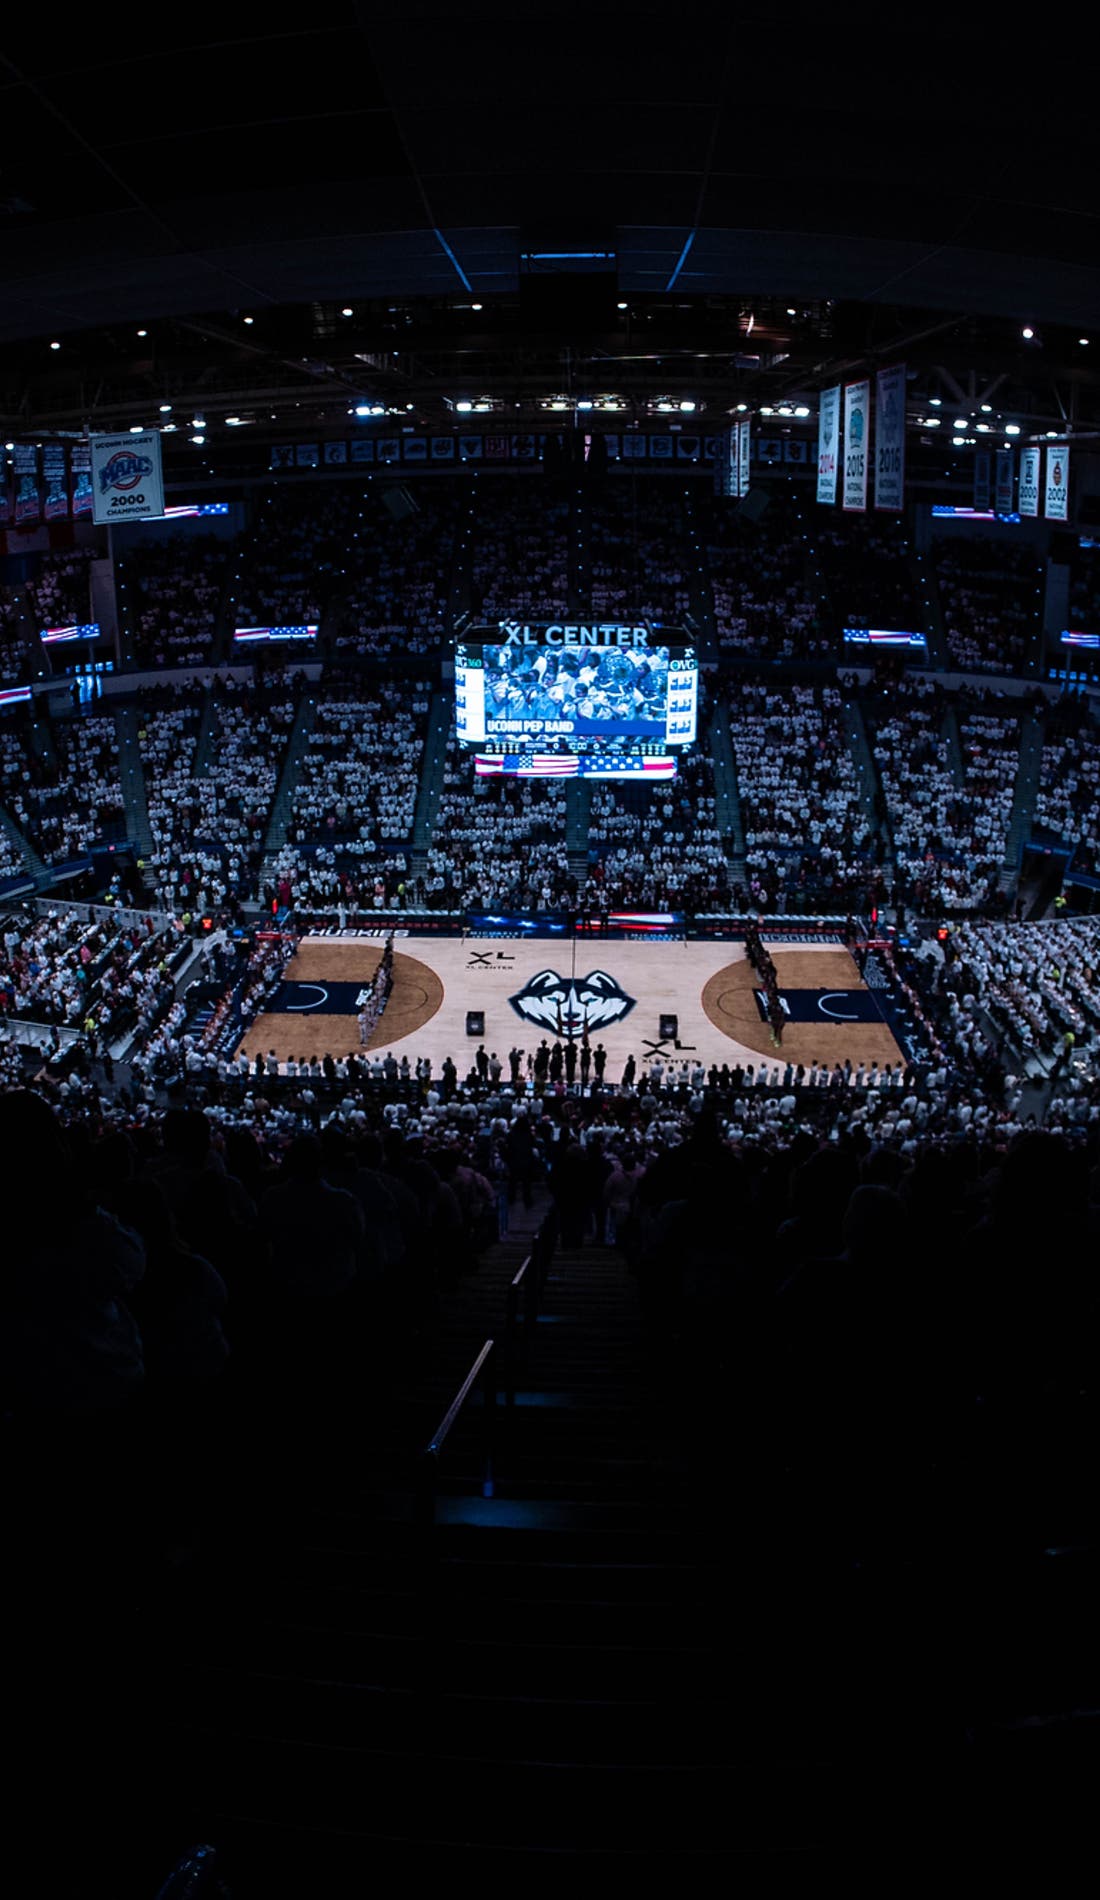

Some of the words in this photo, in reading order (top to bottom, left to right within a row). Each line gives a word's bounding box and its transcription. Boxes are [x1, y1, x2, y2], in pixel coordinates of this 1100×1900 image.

[95, 441, 122, 450] UCONN
[123, 437, 153, 447] HOCKEY
[818, 454, 834, 474] 2014
[846, 454, 864, 477] 2015
[879, 448, 900, 473] 2016
[100, 456, 152, 494] MAAC
[1020, 486, 1036, 498] 2000
[1048, 487, 1066, 501] 2002
[111, 494, 145, 507] 2000
[107, 505, 151, 516] CHAMPIONS
[505, 626, 538, 646] XL
[545, 626, 648, 647] CENTER
[487, 720, 523, 733] UCONN
[523, 720, 544, 733] PEP
[545, 720, 574, 733] BAND
[308, 927, 410, 938] HUSKIES
[468, 951, 515, 965] XL
[641, 1039, 696, 1058] XL
